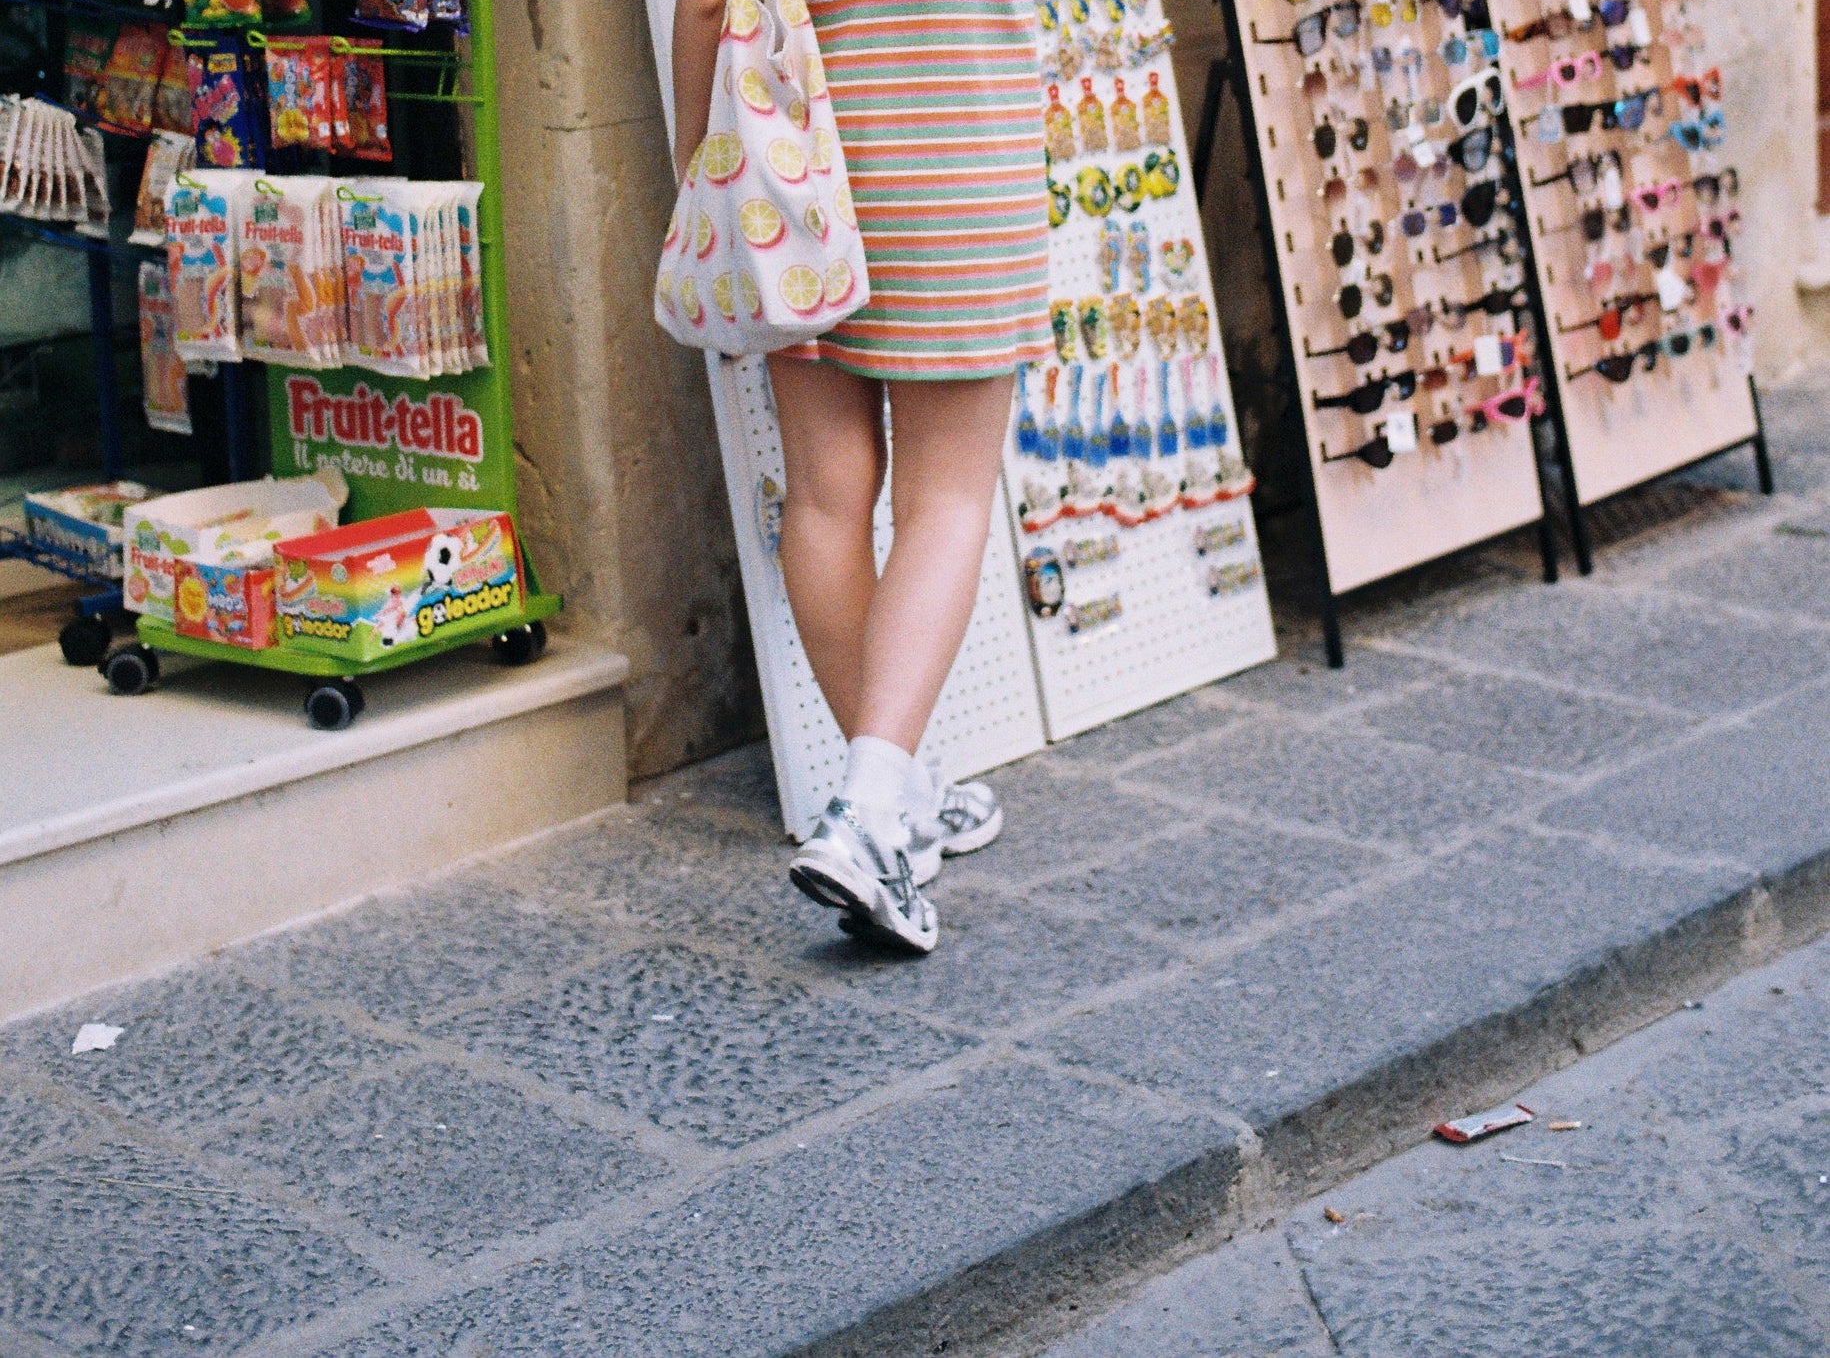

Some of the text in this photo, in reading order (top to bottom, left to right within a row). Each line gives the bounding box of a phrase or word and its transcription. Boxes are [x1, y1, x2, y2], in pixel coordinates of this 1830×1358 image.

[287, 376, 482, 461] Fruit-tella
[395, 453, 417, 482] di
[422, 465, 453, 488] un
[416, 580, 514, 637] goleador
